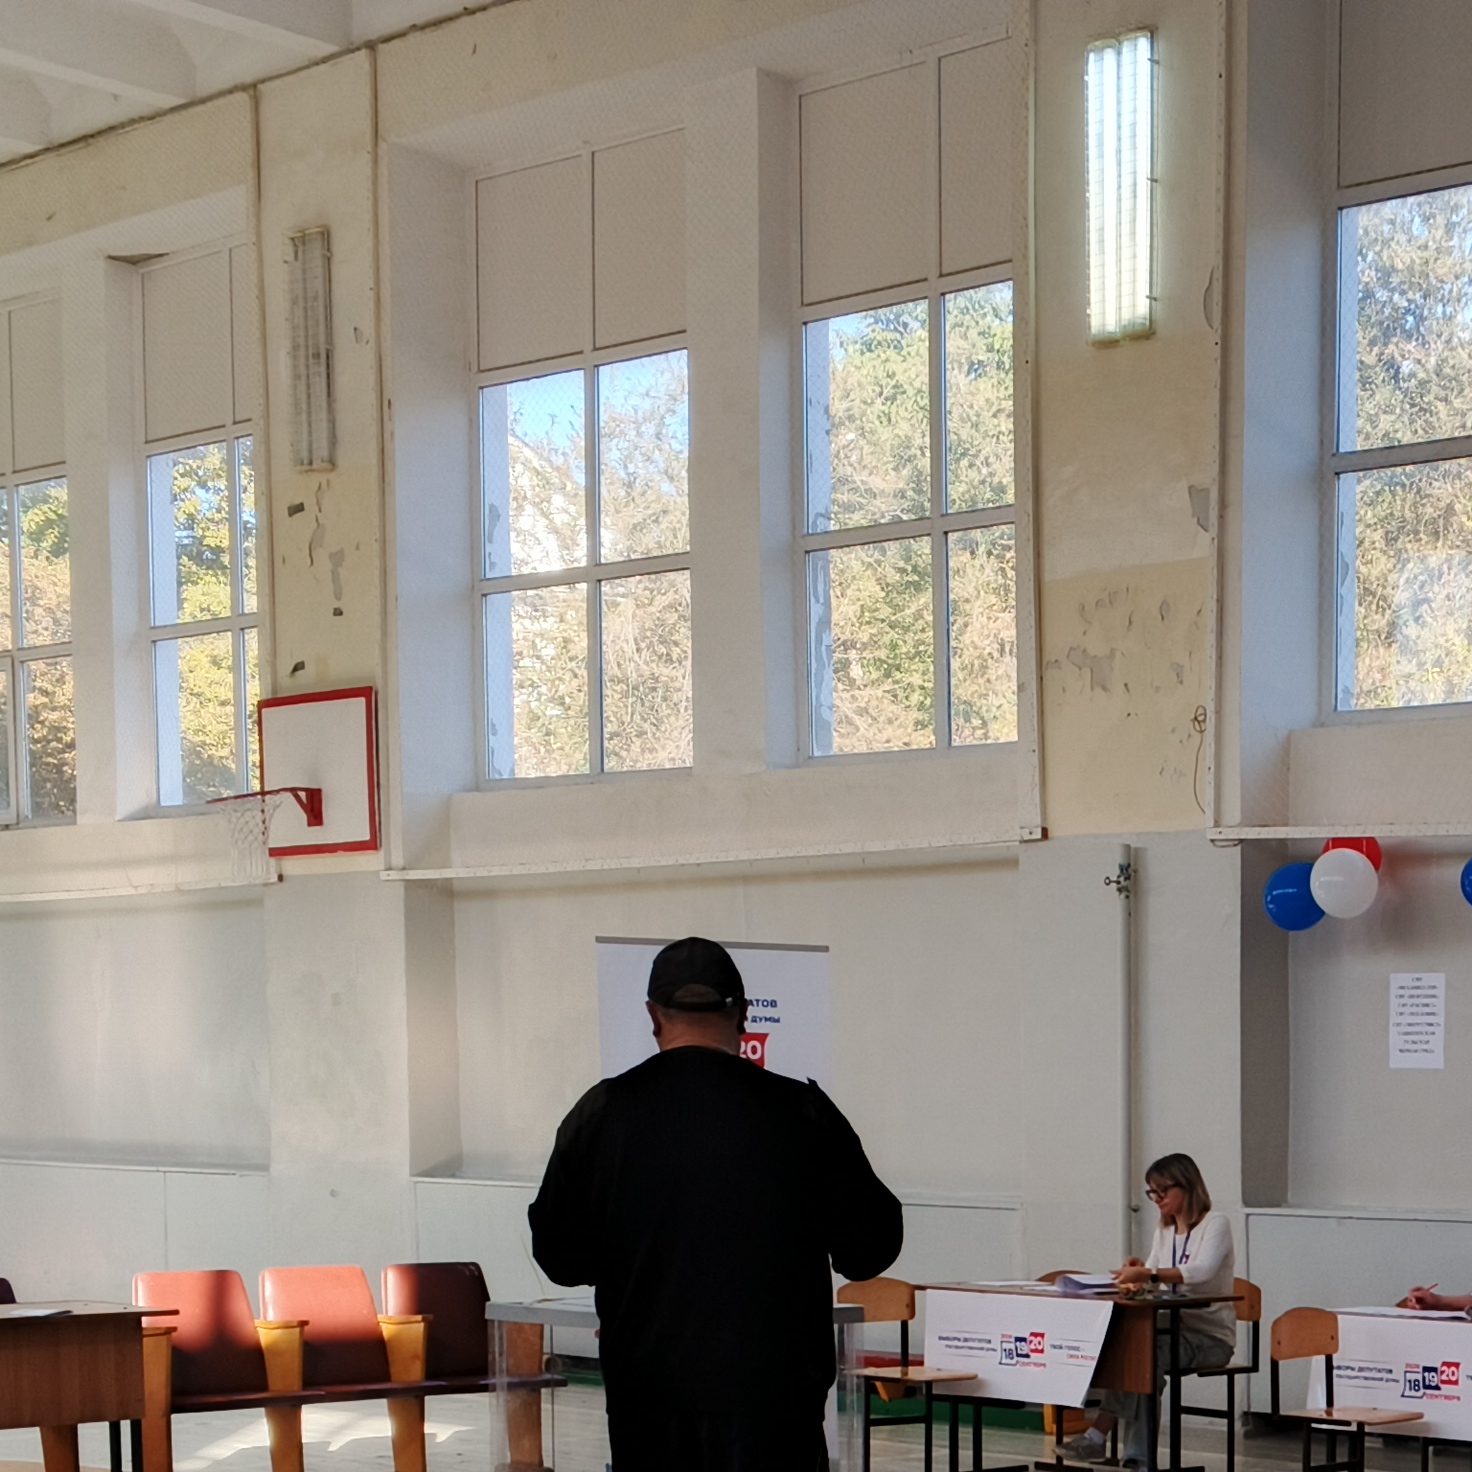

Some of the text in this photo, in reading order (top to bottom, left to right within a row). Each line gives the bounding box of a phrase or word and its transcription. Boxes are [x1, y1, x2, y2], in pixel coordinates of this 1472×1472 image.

[751, 1015, 781, 1024] ДУМЫ
[1015, 1341, 1027, 1355] 19
[1029, 1336, 1043, 1351] 20
[1003, 1348, 1015, 1360] 18
[1423, 1372, 1438, 1386] 19
[1440, 1366, 1459, 1381] 20
[1407, 1379, 1421, 1392] 18
